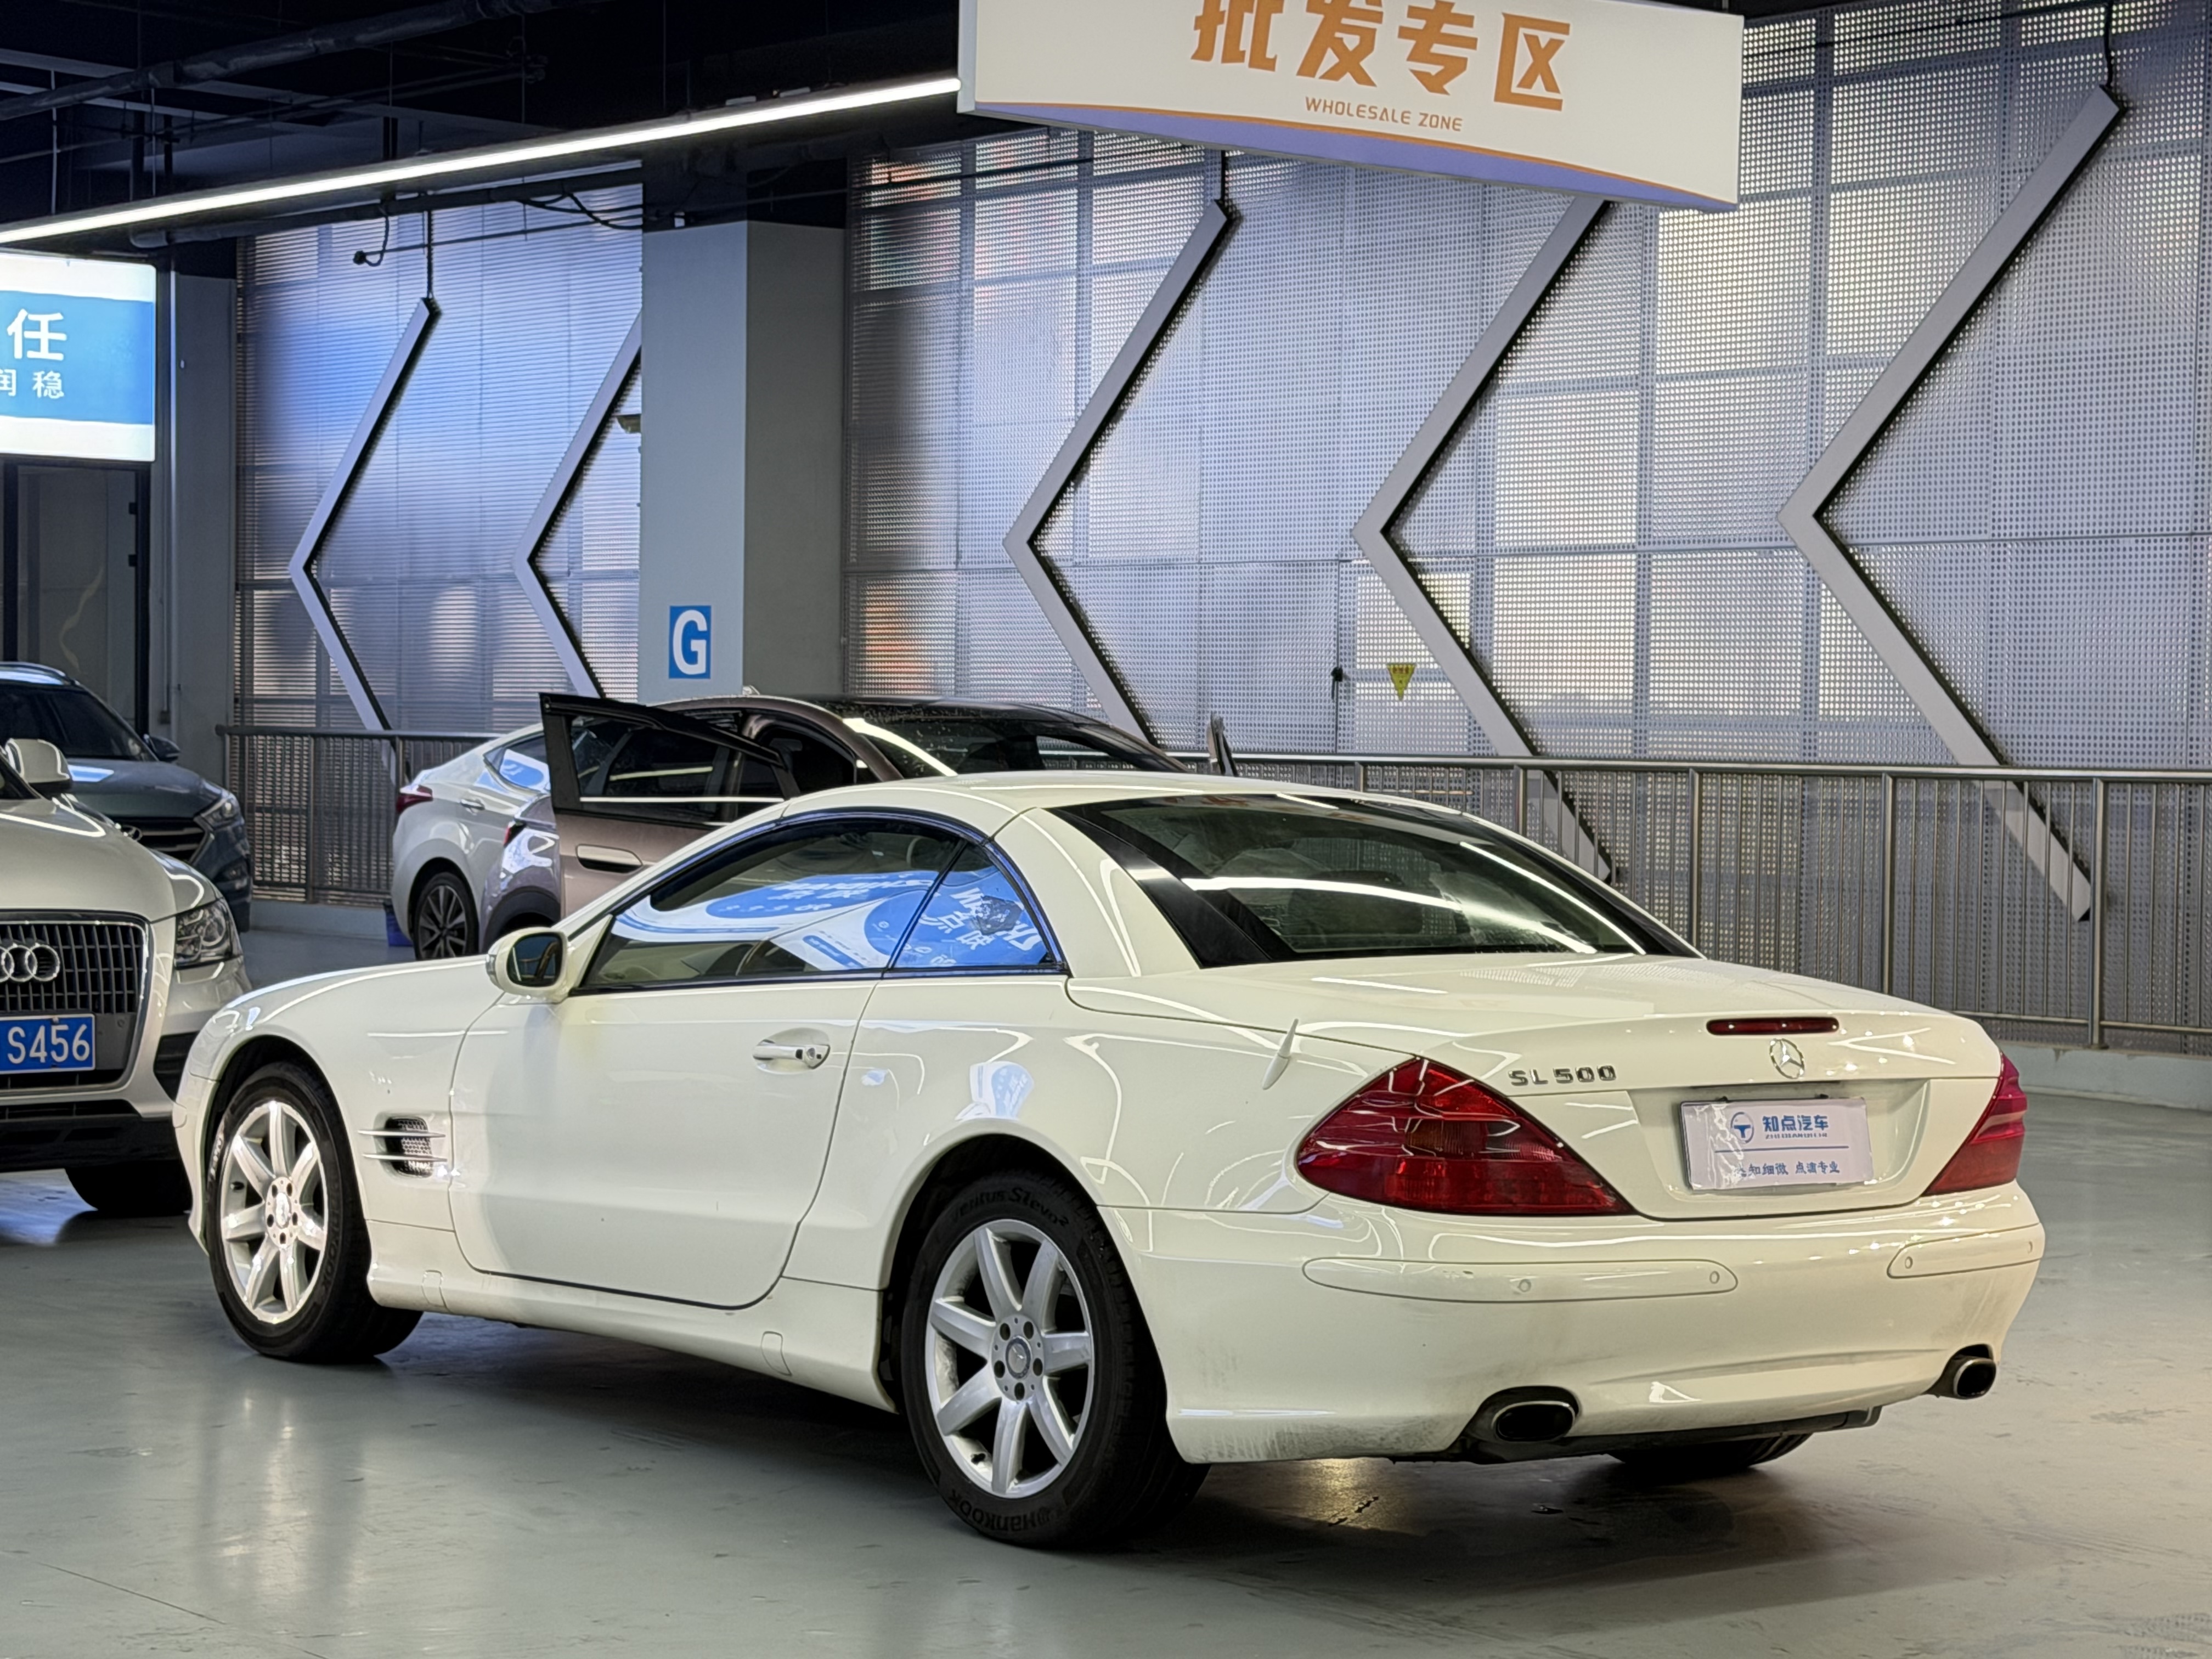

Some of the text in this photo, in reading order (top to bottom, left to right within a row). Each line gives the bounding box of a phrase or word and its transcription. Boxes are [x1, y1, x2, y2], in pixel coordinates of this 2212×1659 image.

[1190, 0, 1571, 111] 批发专区
[1305, 96, 1463, 132] WHOLESALE ZONE
[7, 308, 67, 360] 任
[673, 610, 708, 675] G
[8, 1024, 91, 1064] S456
[1508, 1065, 1617, 1086] SL 500
[1762, 1114, 1829, 1132] 知点汽车
